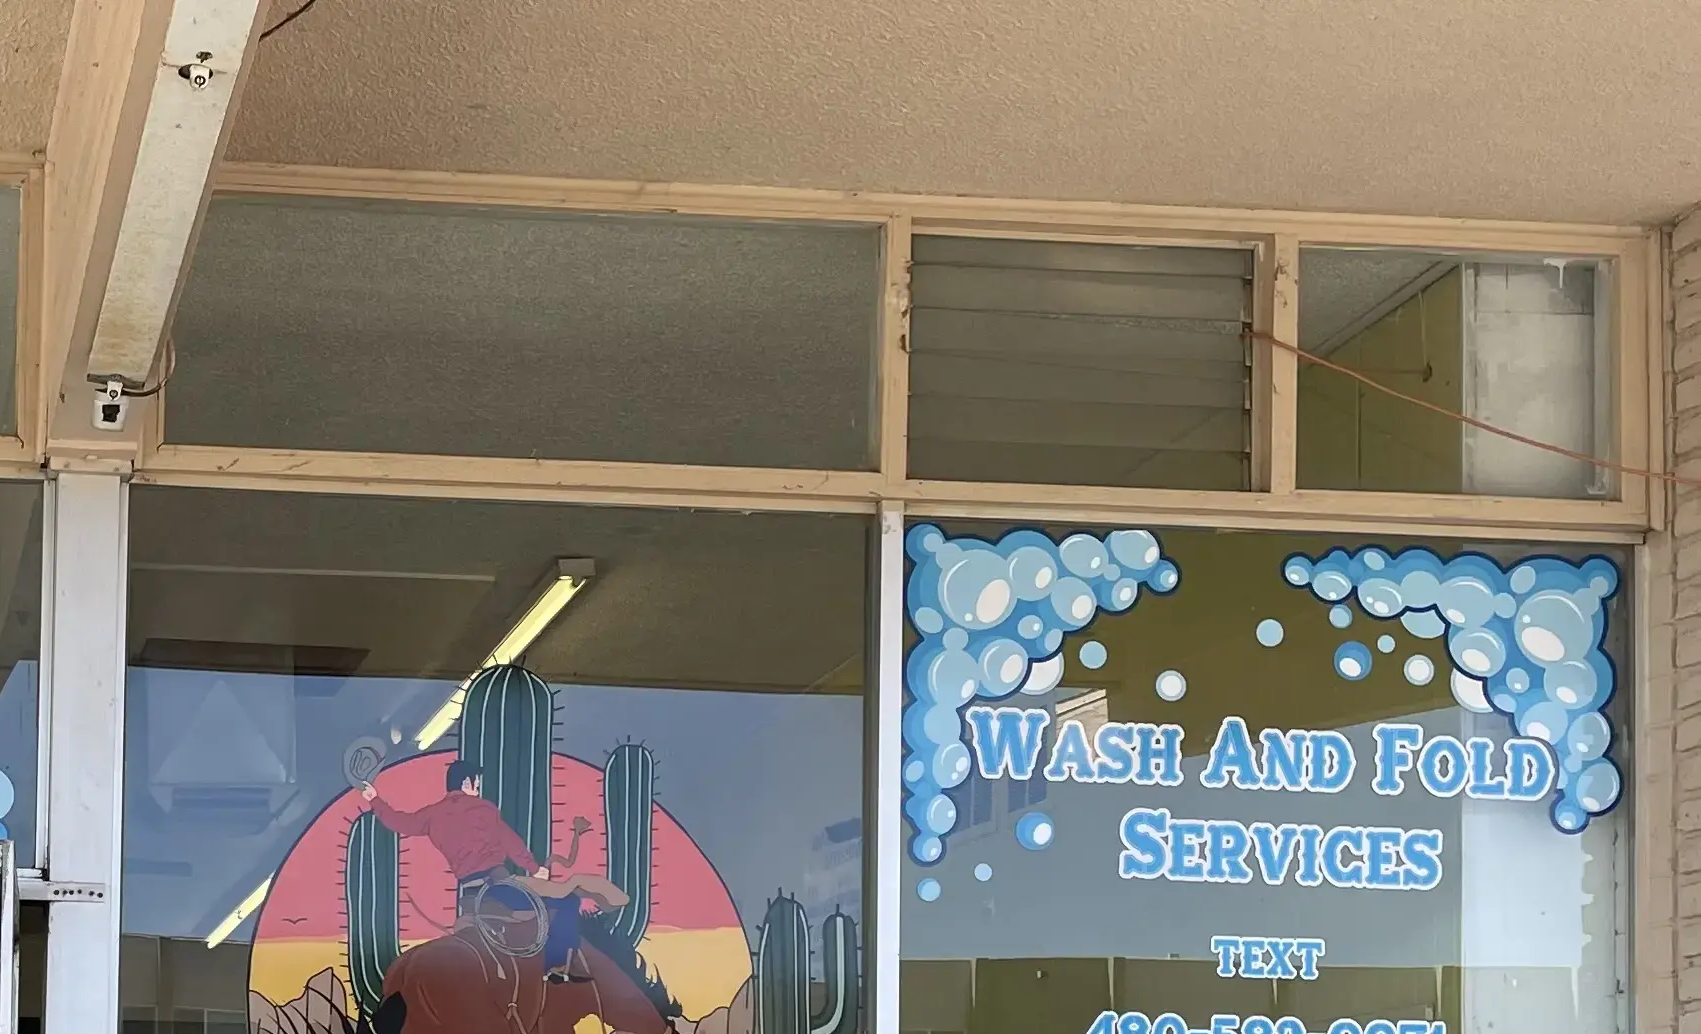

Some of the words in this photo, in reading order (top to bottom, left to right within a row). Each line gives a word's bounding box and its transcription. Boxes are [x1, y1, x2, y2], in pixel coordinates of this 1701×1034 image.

[967, 706, 1185, 787] WASH
[1198, 716, 1356, 794] AND
[1371, 724, 1557, 800] FOLD
[1117, 808, 1444, 890] SERVICES
[1210, 934, 1326, 980] TEXT
